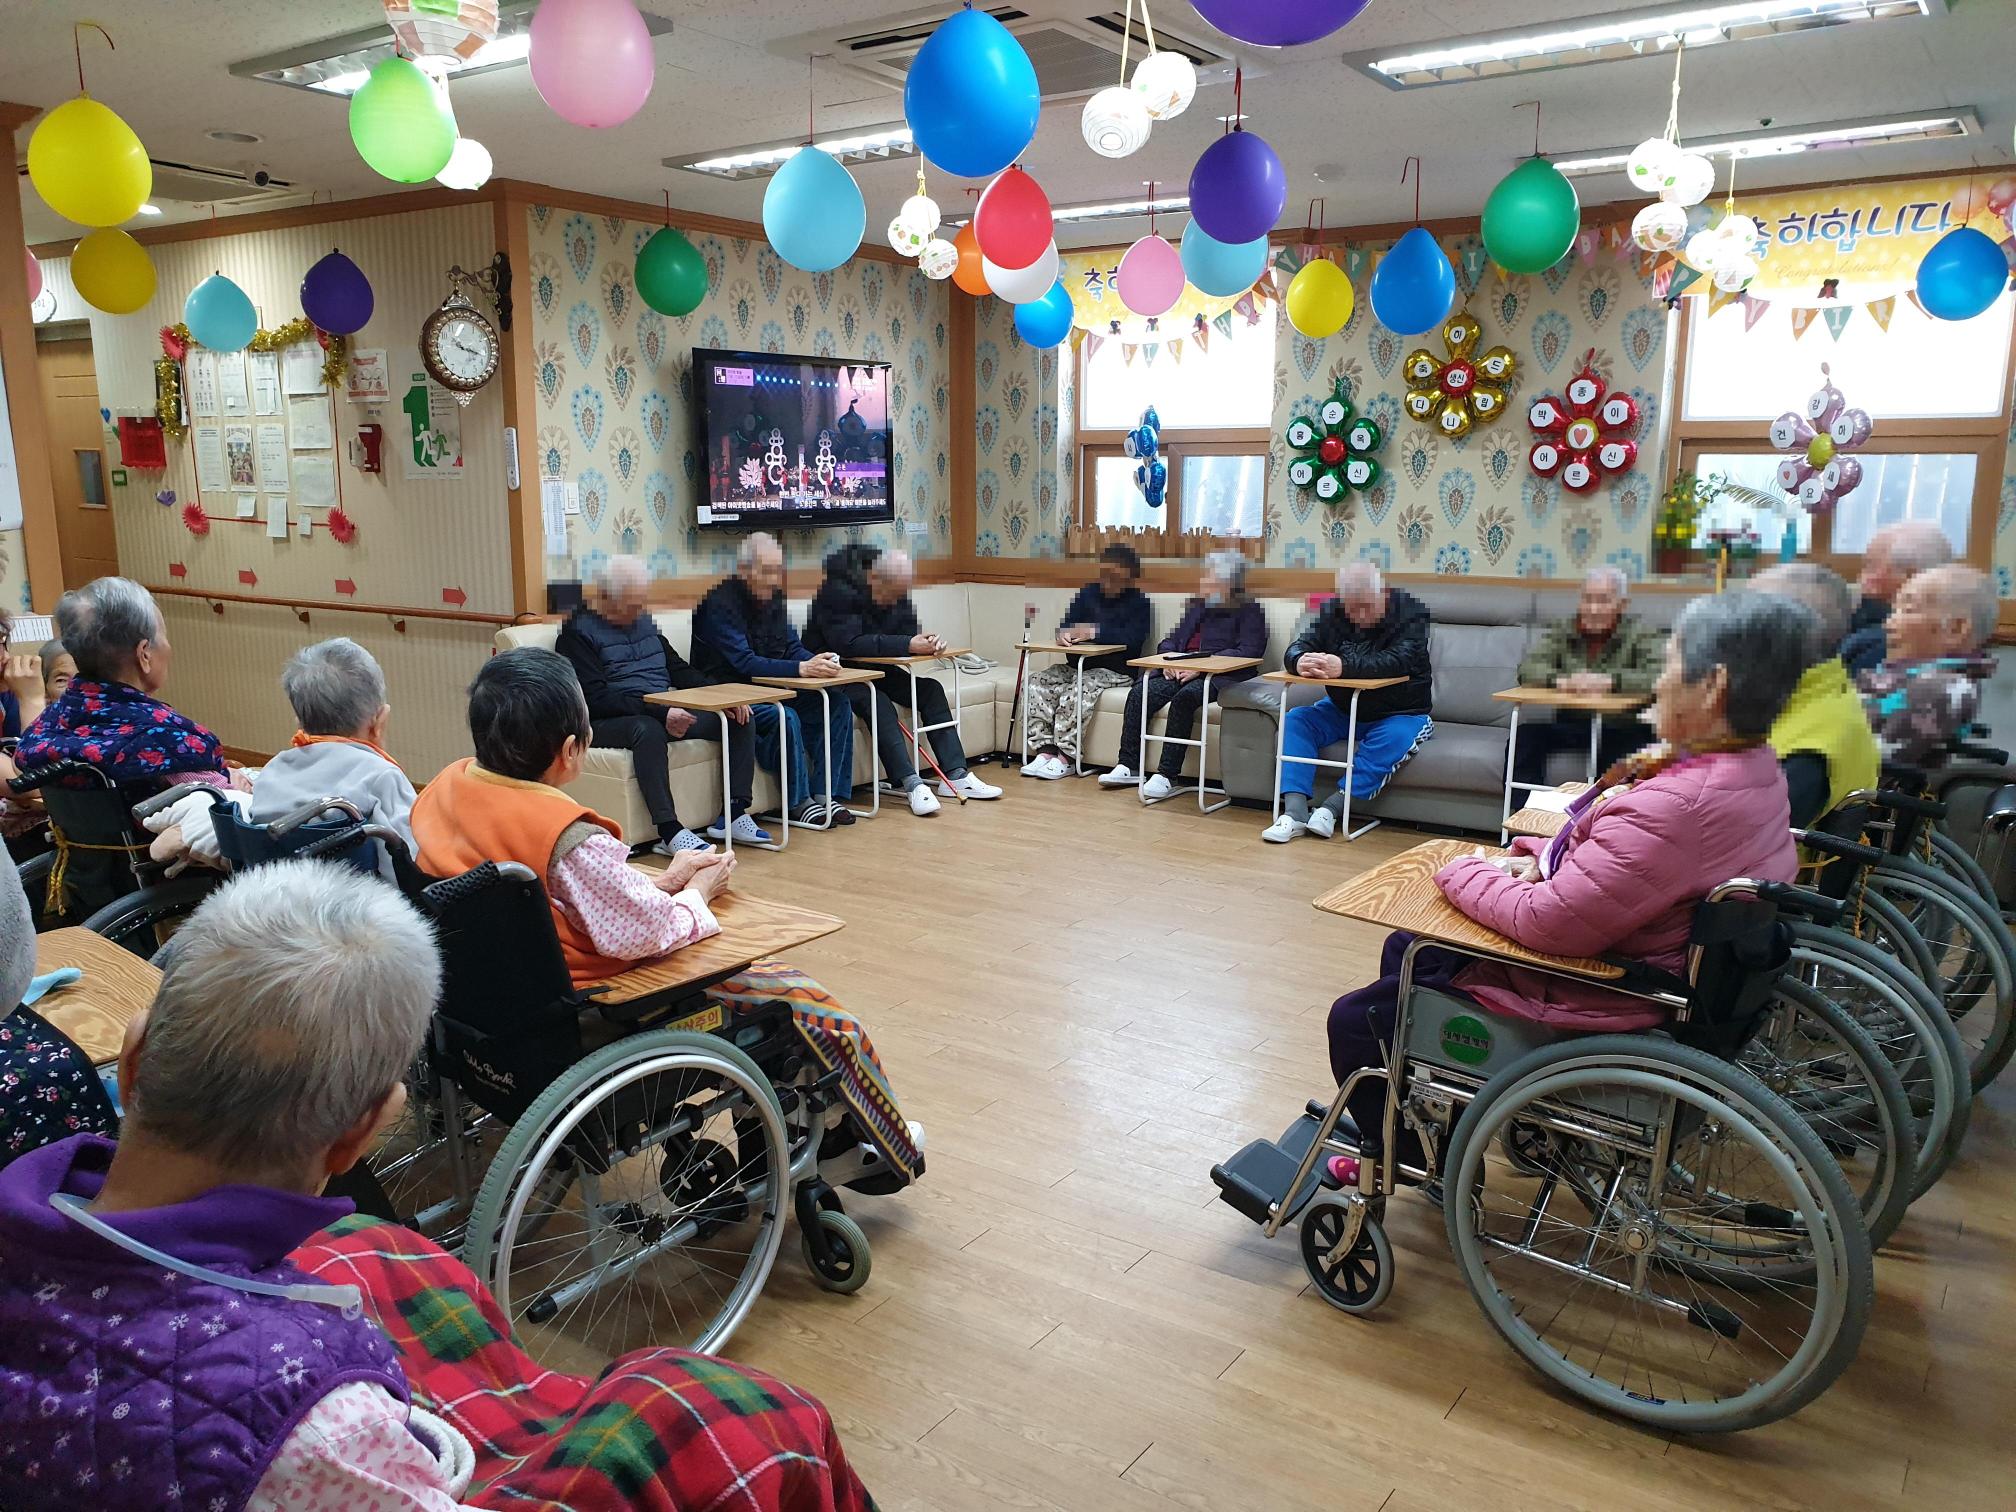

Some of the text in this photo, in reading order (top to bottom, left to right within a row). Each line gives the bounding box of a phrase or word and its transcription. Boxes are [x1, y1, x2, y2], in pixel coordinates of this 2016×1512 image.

[1490, 360, 1501, 371] 드
[1449, 373, 1465, 383] 생신
[1538, 386, 1619, 420] 박 종 이
[1328, 409, 1337, 419] 순
[1446, 417, 1455, 427] 니
[1539, 451, 1617, 481] 어 르 신
[1296, 468, 1362, 491] 어 르 신
[1806, 488, 1814, 498] 요
